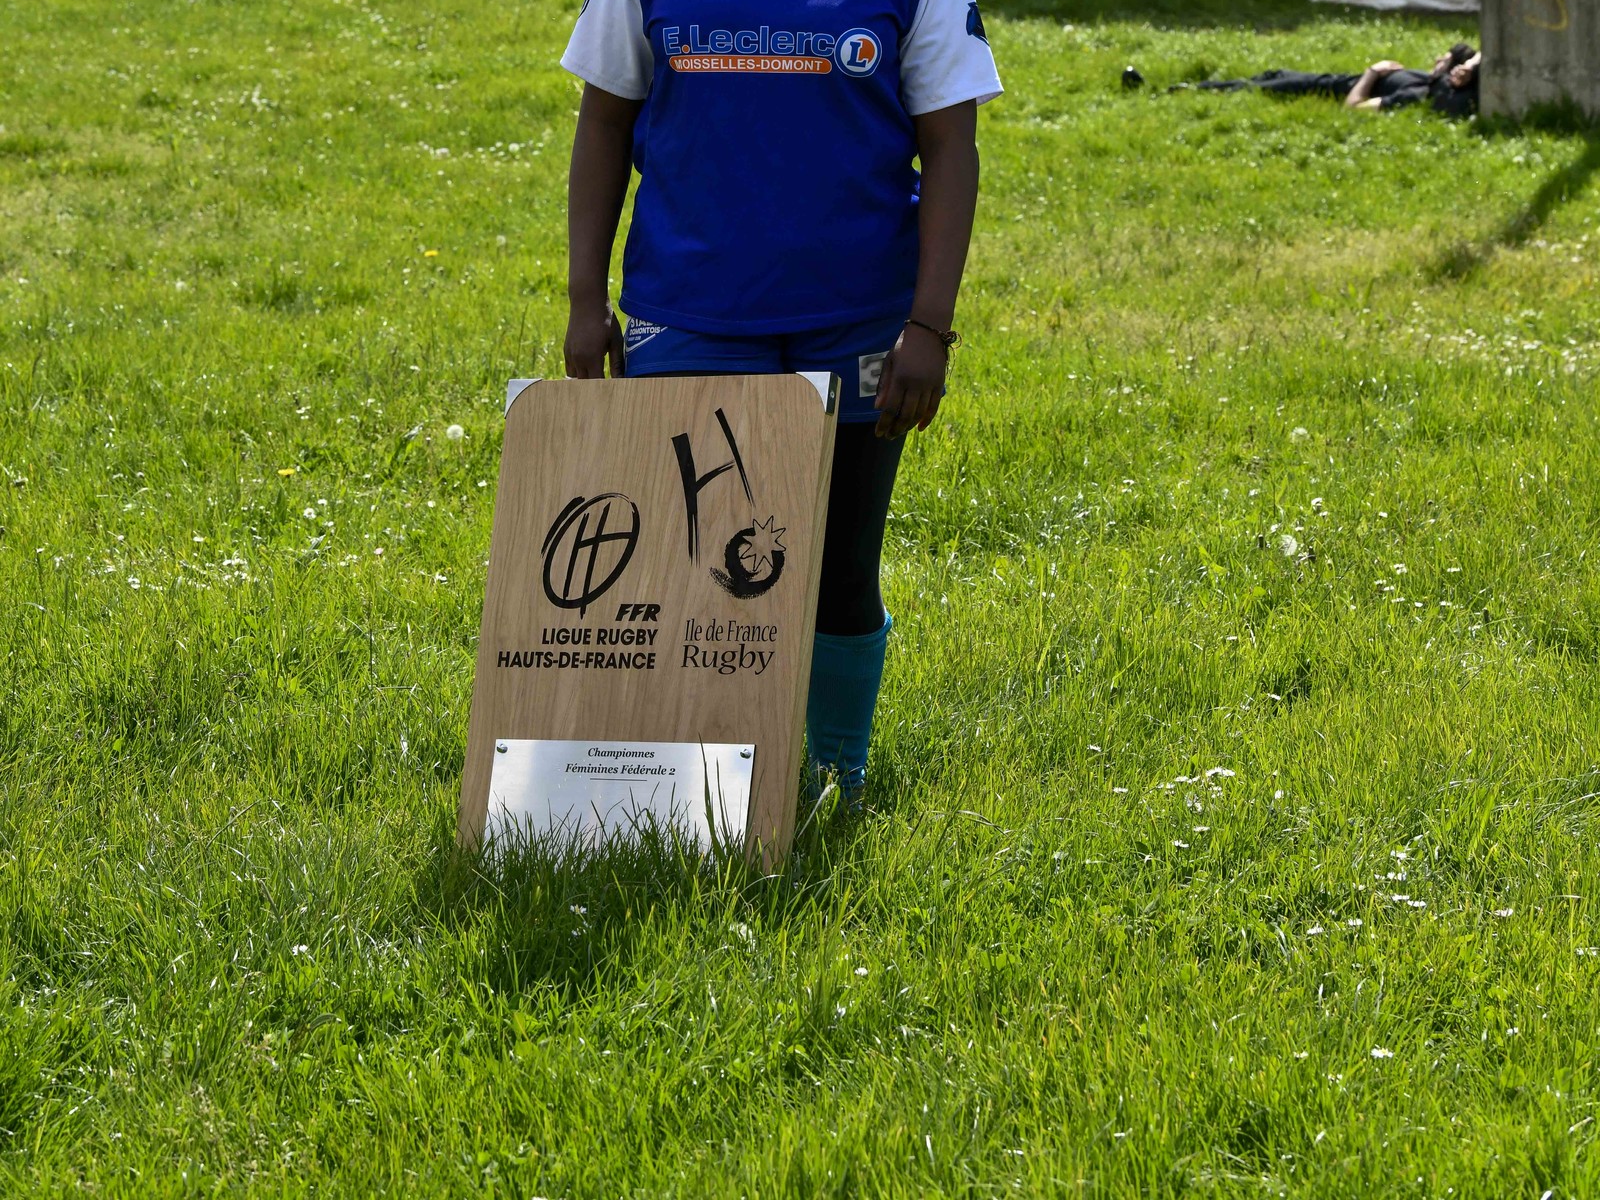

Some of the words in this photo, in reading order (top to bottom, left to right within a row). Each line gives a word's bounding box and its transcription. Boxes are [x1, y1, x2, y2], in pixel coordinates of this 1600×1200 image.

[662, 24, 835, 57] E.Leclerc
[674, 57, 823, 72] MOISSELLES-DOMONT
[615, 603, 661, 622] FFR
[541, 628, 592, 645] LIGUE
[596, 628, 658, 646] RUGBY
[684, 618, 702, 642] Ile
[705, 618, 724, 642] de
[726, 620, 778, 642] France
[497, 651, 656, 670] HAUTS-DE-FRANCE
[680, 643, 775, 675] Rugby
[587, 747, 655, 760] Championnes
[565, 763, 619, 774] Féminines
[620, 764, 667, 776] Fédérale
[668, 767, 676, 776] 2
